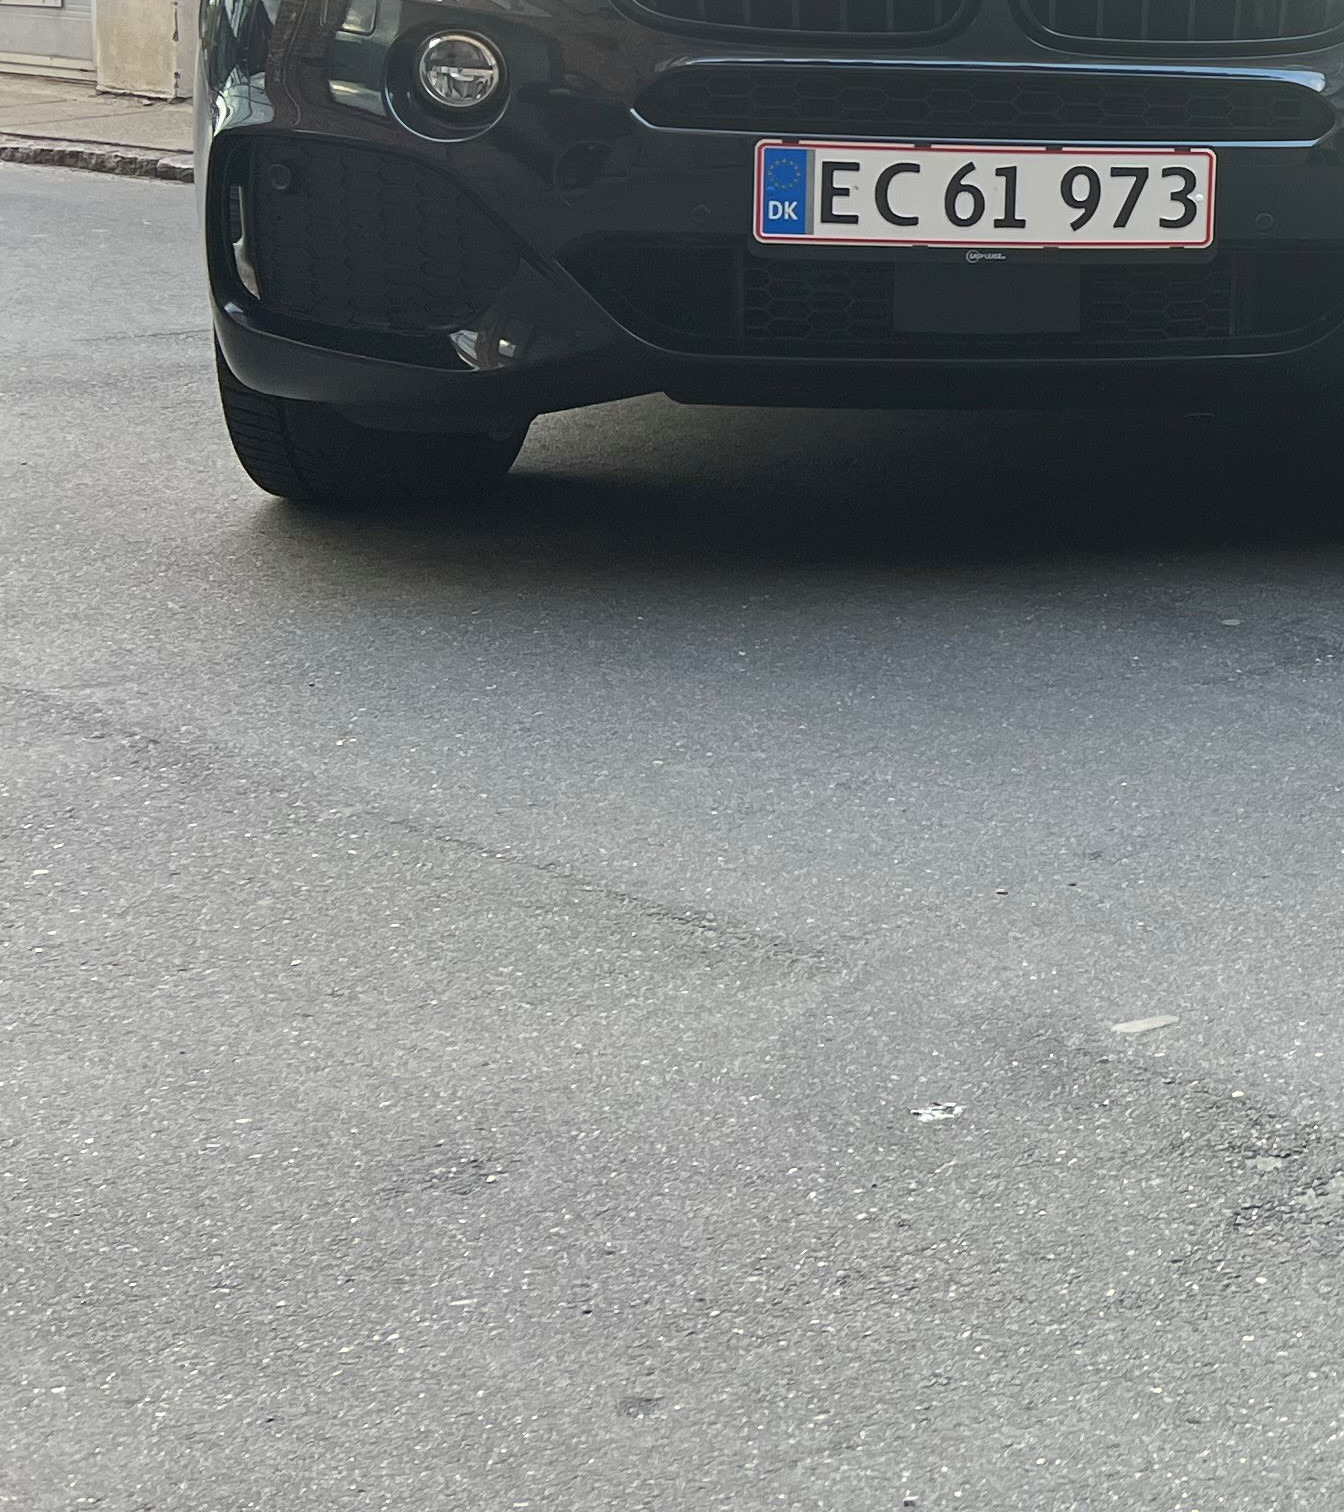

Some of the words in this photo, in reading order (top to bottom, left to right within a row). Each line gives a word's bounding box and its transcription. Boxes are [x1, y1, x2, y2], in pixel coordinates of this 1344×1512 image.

[768, 200, 798, 221] DK
[820, 160, 920, 226] EC
[944, 161, 1026, 228] 61
[1060, 165, 1198, 231] 973
